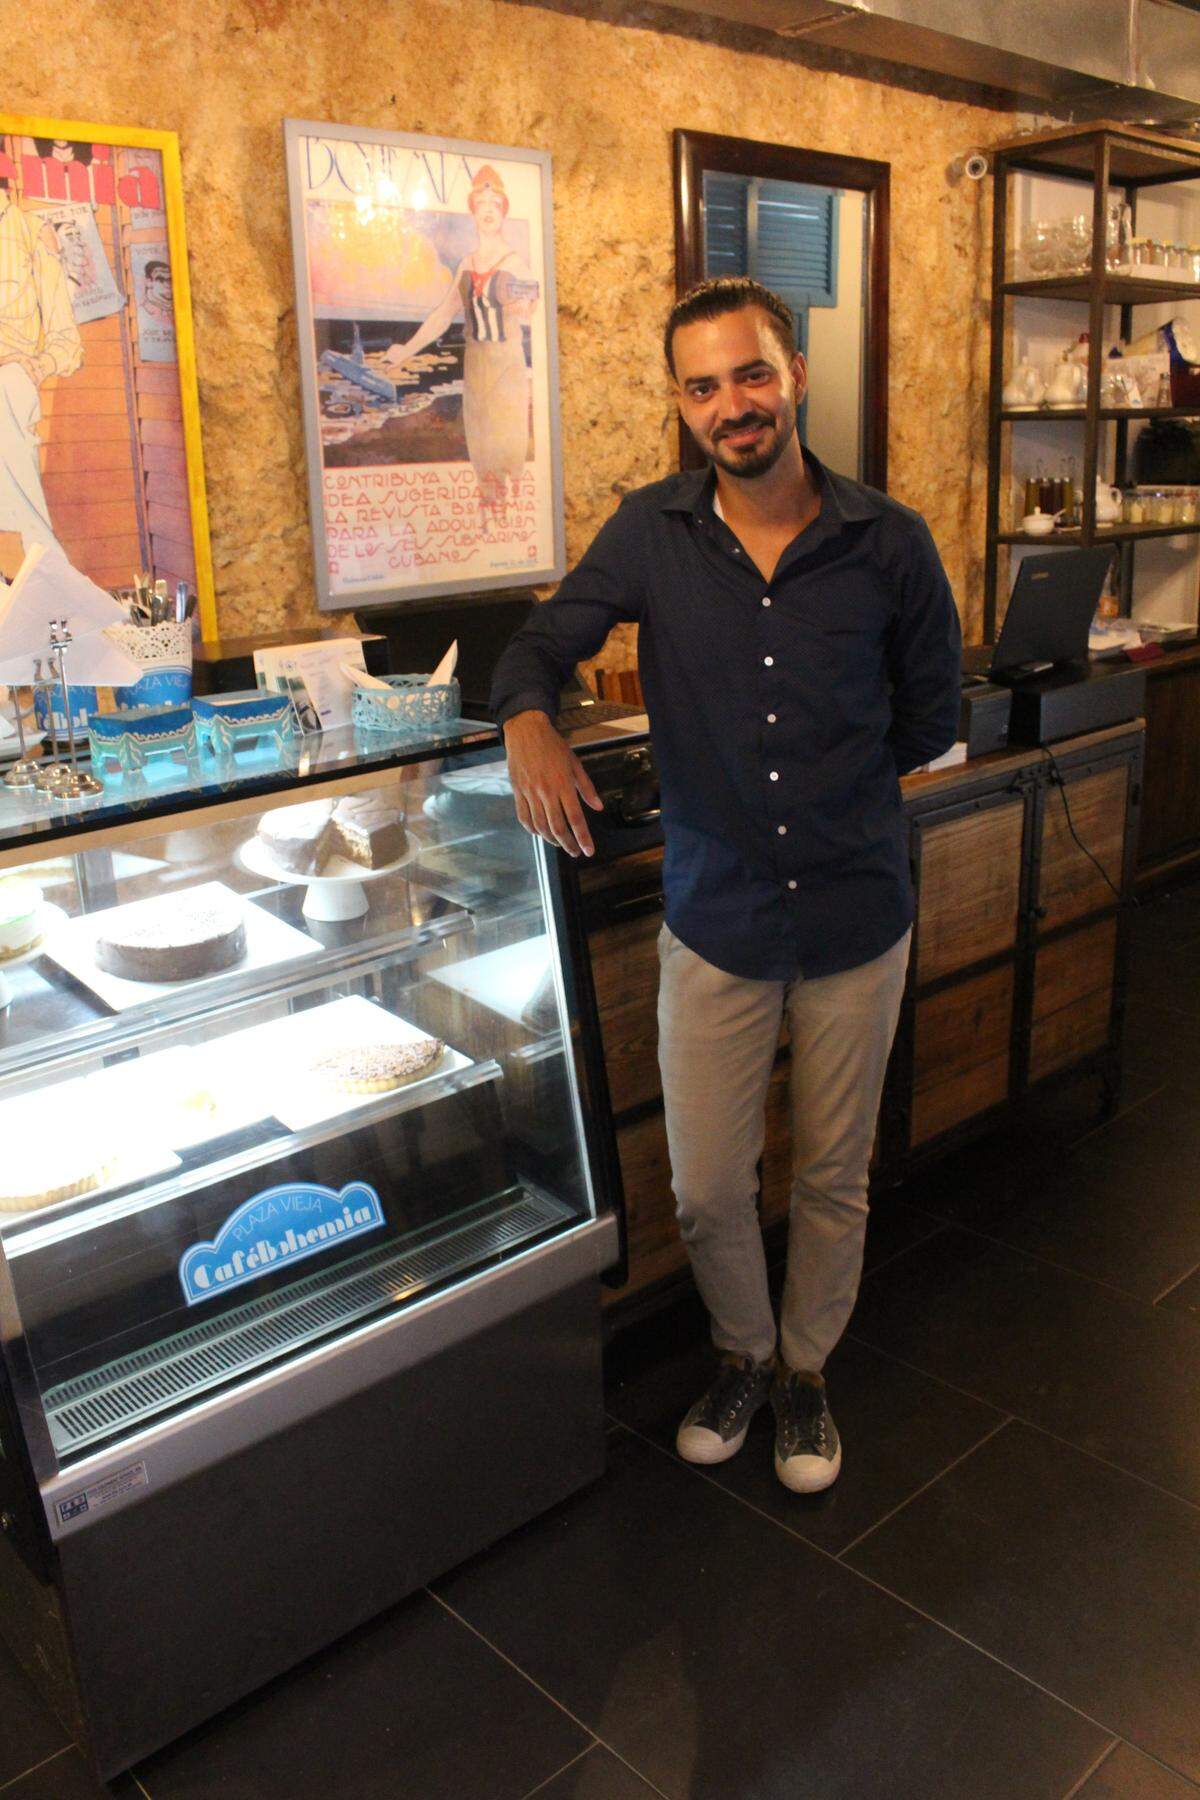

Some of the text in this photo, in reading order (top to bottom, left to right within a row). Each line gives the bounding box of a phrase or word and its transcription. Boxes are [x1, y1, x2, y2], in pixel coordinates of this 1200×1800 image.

[324, 472, 440, 490] CONTRIBUYA
[324, 490, 371, 507] IDEA
[378, 485, 484, 504] SUGERIDA
[325, 511, 349, 525] LA
[357, 504, 441, 522] REVISTA
[326, 526, 379, 541] PARA
[389, 522, 417, 537] LA
[328, 545, 350, 559] DE
[232, 1194, 323, 1241] PLAZA VIEJA
